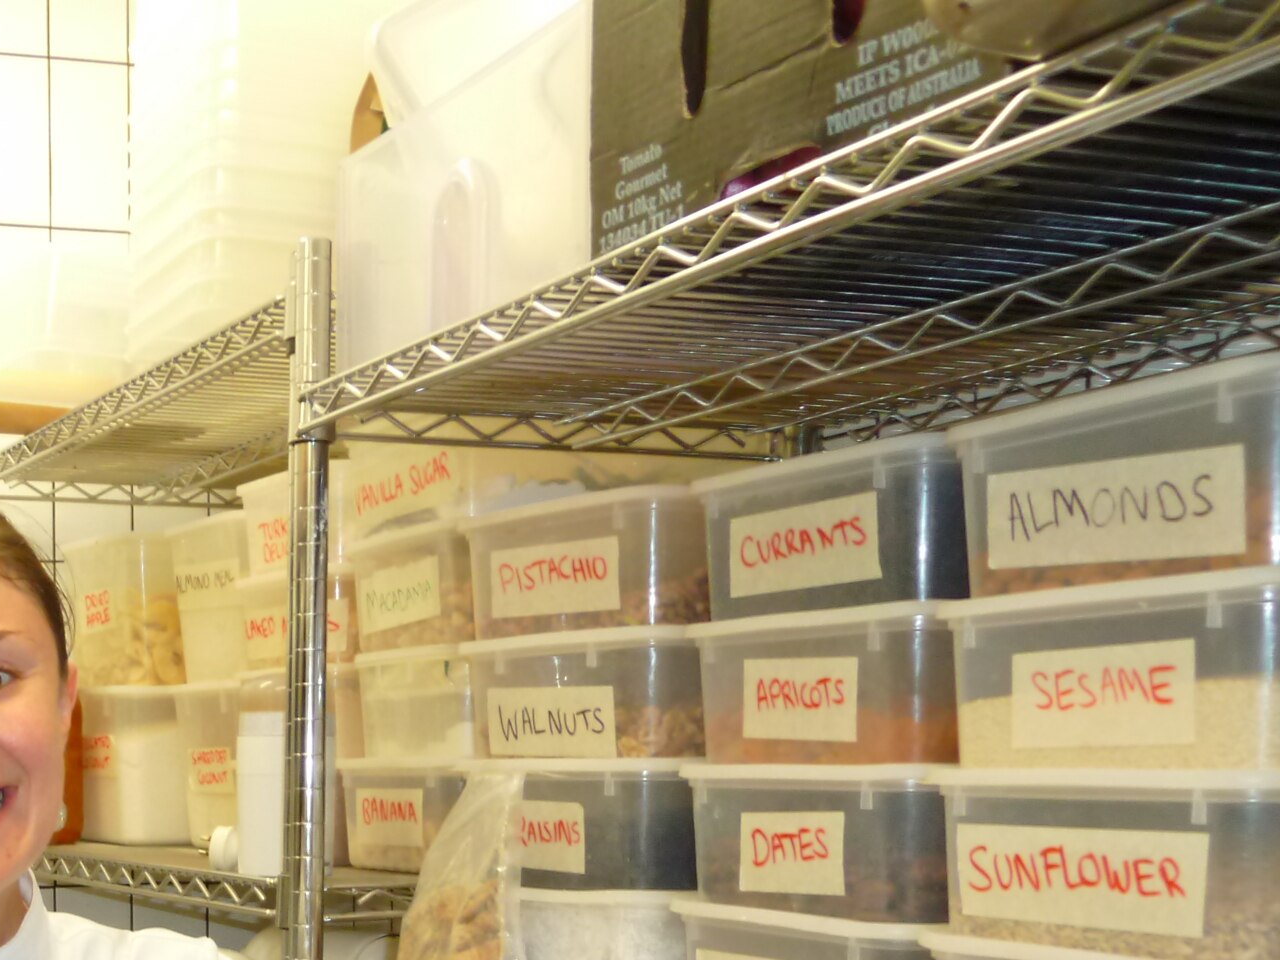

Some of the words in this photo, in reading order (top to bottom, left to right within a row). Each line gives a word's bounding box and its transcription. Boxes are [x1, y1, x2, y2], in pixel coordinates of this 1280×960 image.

[826, 95, 887, 136] PRODUCE
[887, 87, 907, 112] OF
[907, 58, 982, 105] AUSTRALIA
[835, 60, 901, 104] MEETS
[619, 143, 663, 175] Tomato
[615, 162, 668, 201] Gourmet
[659, 180, 682, 205] Net
[355, 473, 404, 517] VANILLA
[409, 450, 451, 495] SUGAR
[1006, 472, 1214, 543] ALMONDS
[258, 518, 289, 541] TURK
[739, 515, 868, 569] CURRANTS
[498, 554, 608, 594] PISTACHIO
[755, 676, 846, 712] APRICOTS
[1030, 665, 1177, 711] SESAME
[497, 704, 606, 743] WALNUTS
[362, 797, 418, 827] BANANA
[750, 826, 830, 868] DATES
[967, 845, 1187, 900] SUNFLOWER
